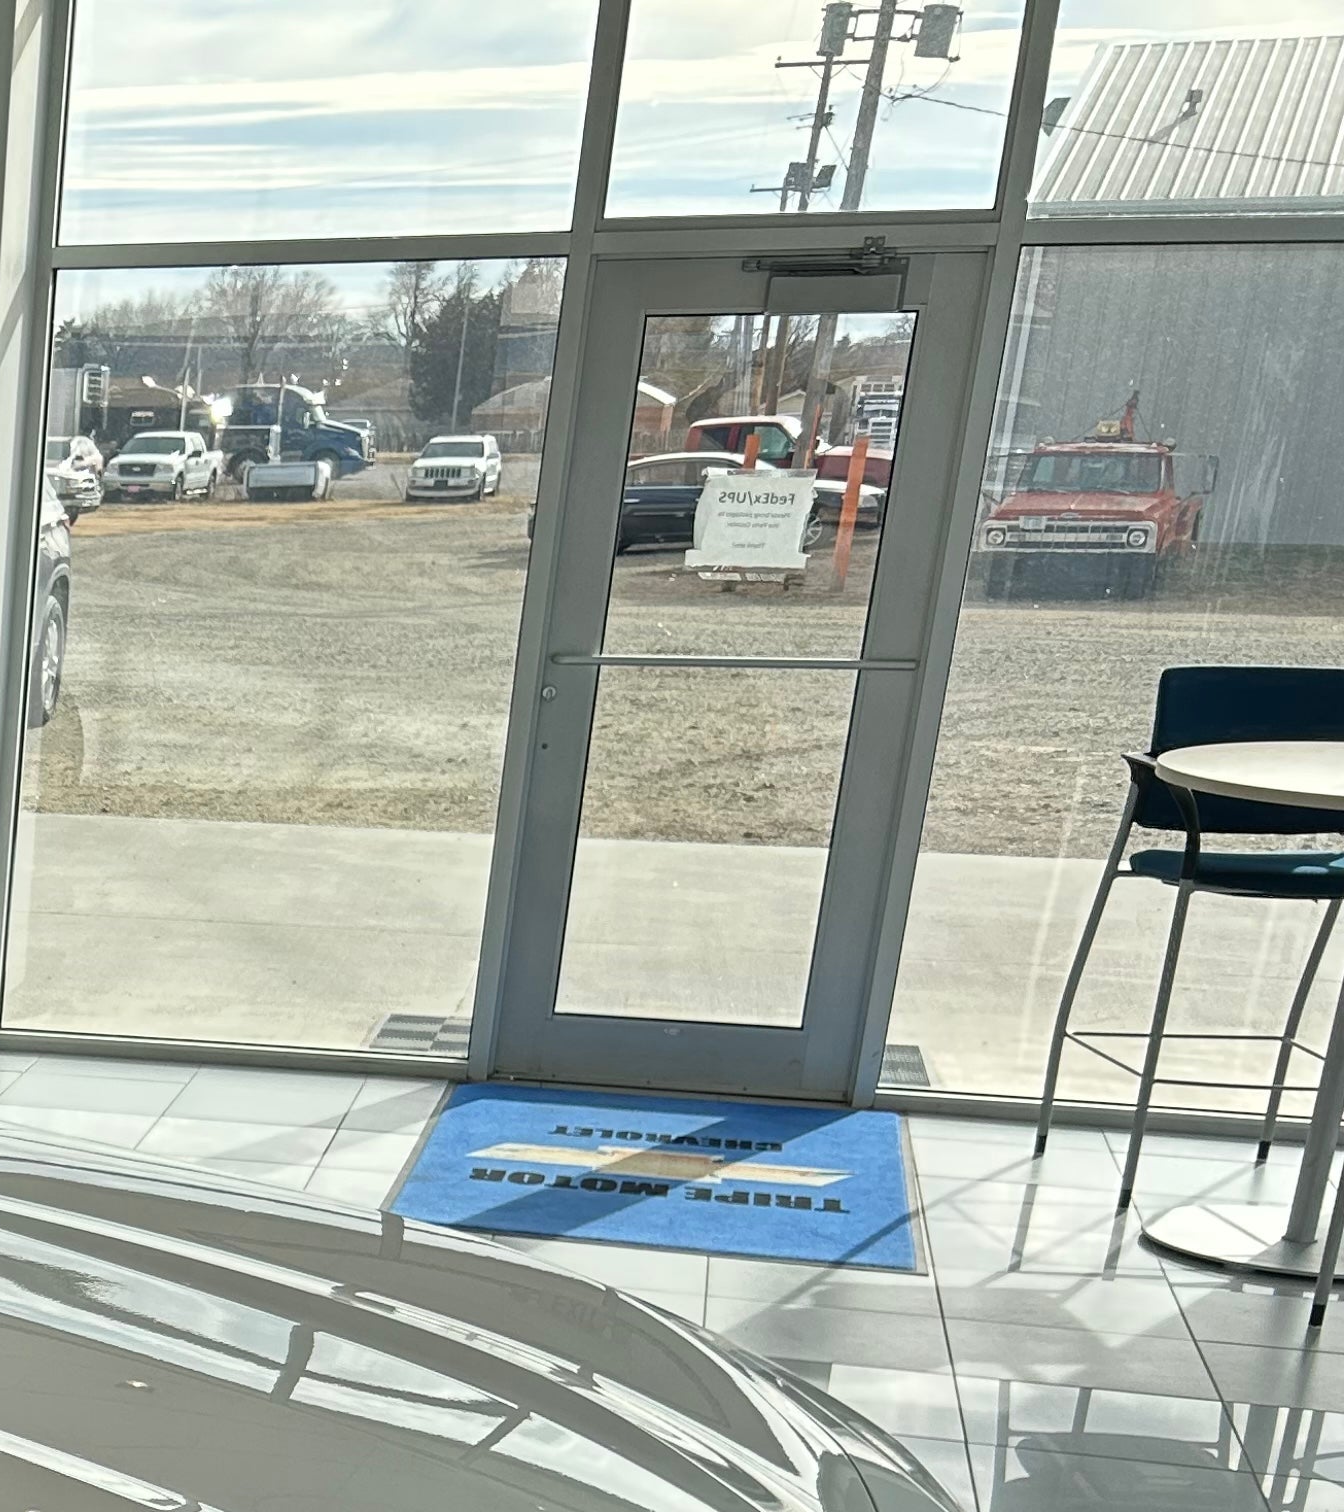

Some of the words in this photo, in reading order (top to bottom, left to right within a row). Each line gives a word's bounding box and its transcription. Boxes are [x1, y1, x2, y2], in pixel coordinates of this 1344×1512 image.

[546, 1125, 783, 1152] CHEVROLET
[469, 1167, 670, 1197] MOTOR
[684, 1186, 851, 1215] TRIPE
